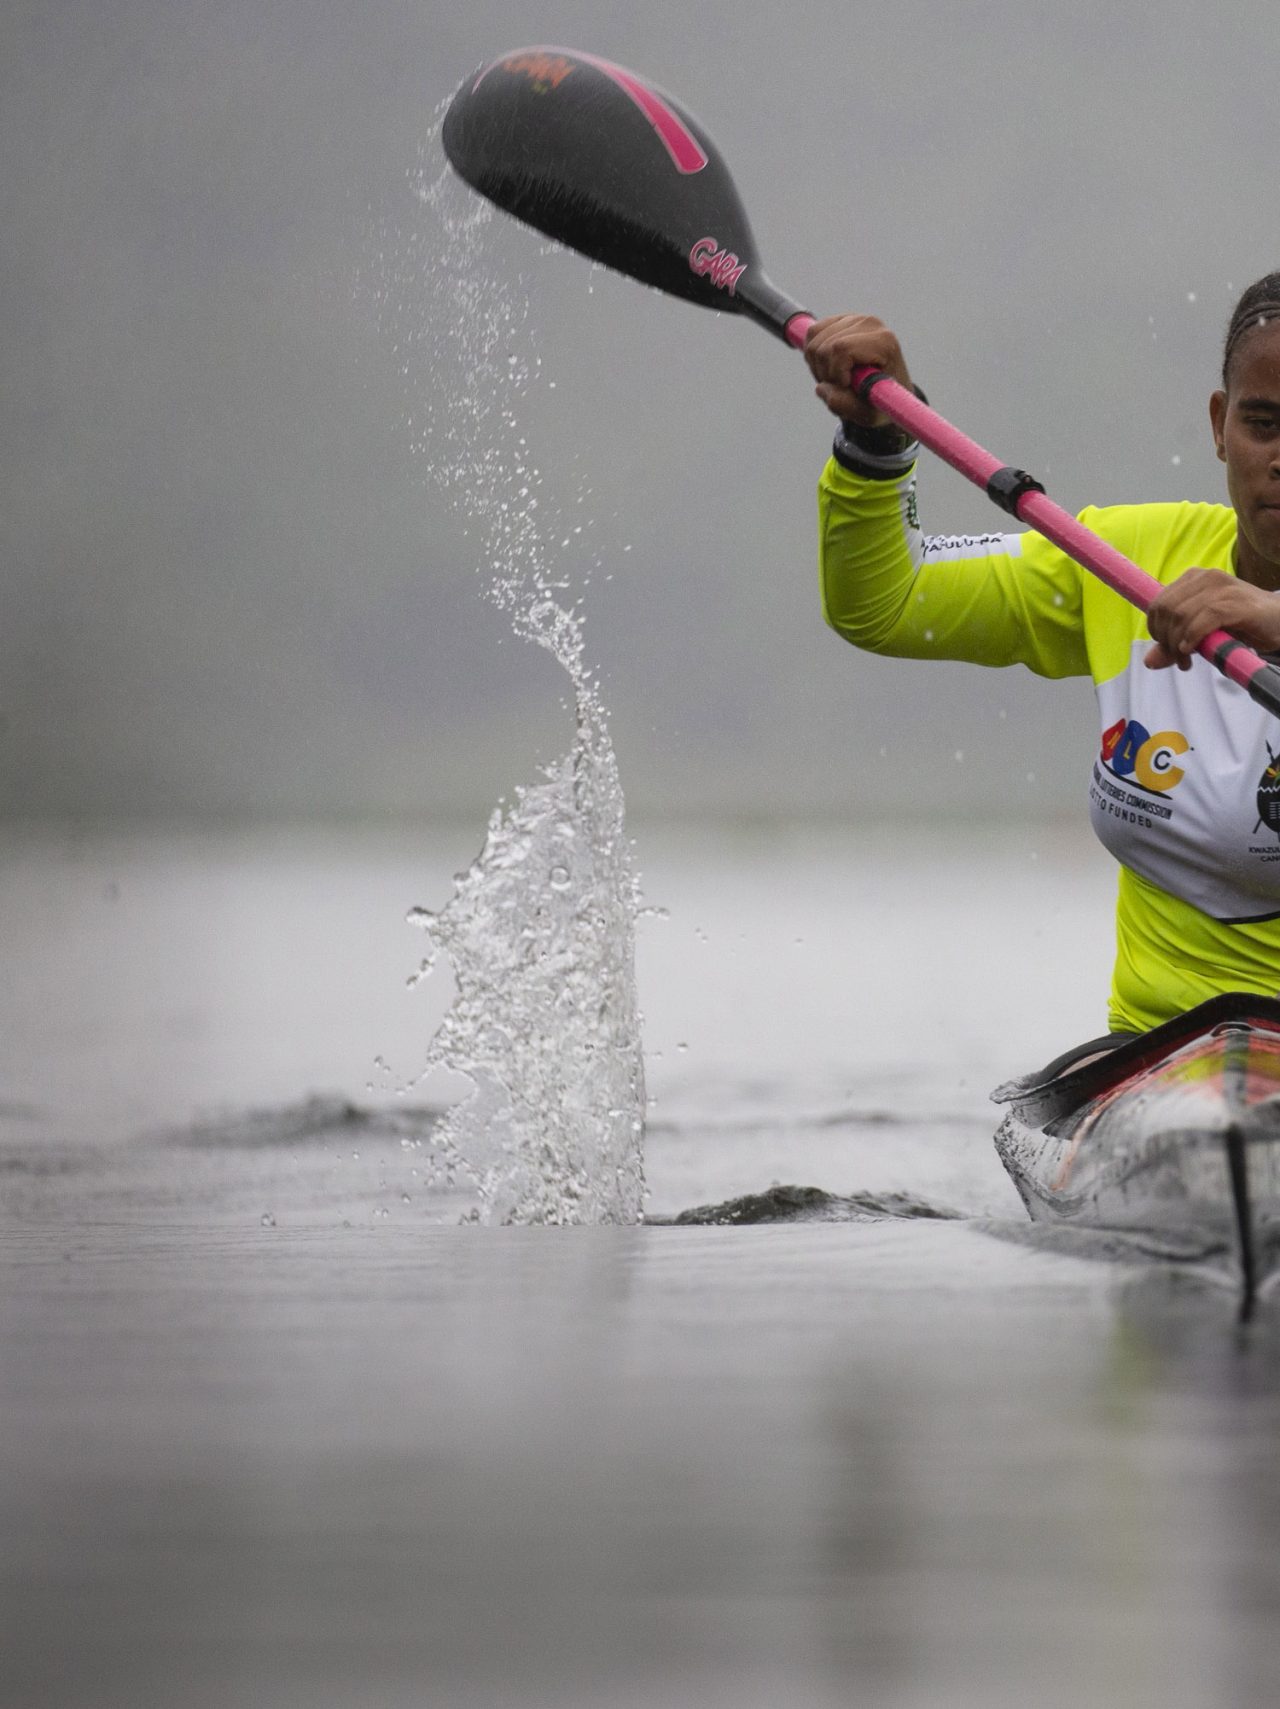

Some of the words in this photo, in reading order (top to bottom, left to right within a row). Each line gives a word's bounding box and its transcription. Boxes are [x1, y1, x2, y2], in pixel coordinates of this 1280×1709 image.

[689, 236, 748, 297] GARA
[1108, 802, 1152, 828] FUNDED
[1126, 794, 1173, 820] COMMISSION
